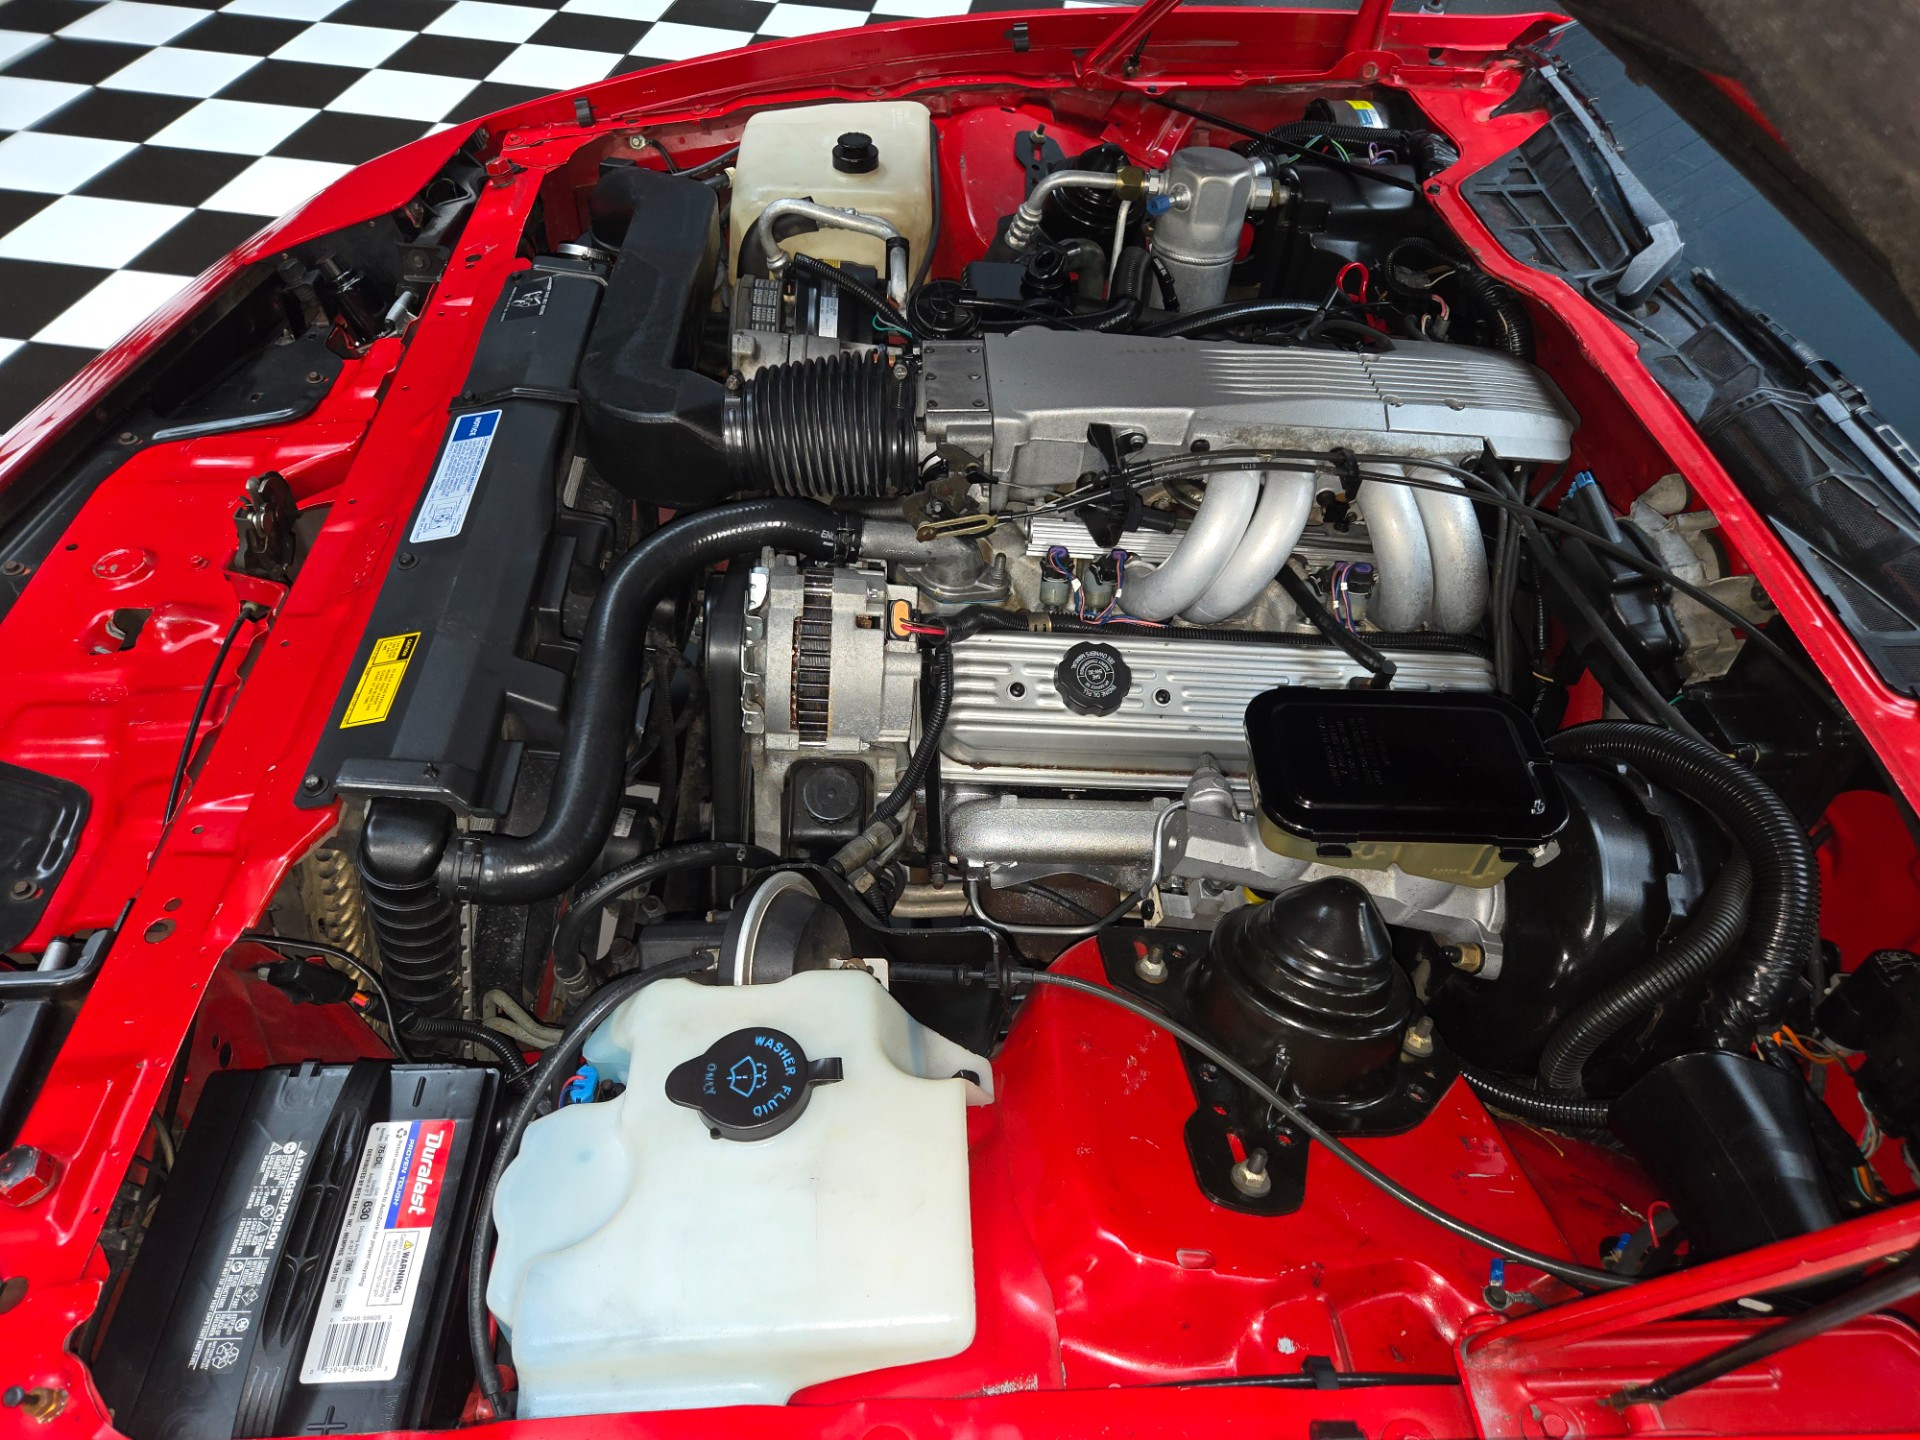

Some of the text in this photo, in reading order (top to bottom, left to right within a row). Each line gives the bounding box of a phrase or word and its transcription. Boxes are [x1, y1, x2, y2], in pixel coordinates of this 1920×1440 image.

[468, 416, 481, 436] NOTICE
[703, 1062, 717, 1095] ONLY
[752, 1035, 797, 1117] WASHER FLUID
[359, 1148, 373, 1179] DISTRIBUTED
[373, 1144, 386, 1167] 75-DL
[392, 1138, 414, 1206] PROVEN TOUGH
[407, 1130, 444, 1215] Duralast
[264, 1158, 304, 1249] DANGER/POISON
[353, 1187, 362, 1198] BEST
[359, 1201, 373, 1220] 630
[374, 1203, 385, 1229] AutoZone
[365, 1239, 375, 1259] proper
[329, 1266, 339, 1282] 38103
[358, 1260, 370, 1286] recycling
[392, 1251, 410, 1293] WARNING:
[334, 1299, 342, 1308] 95
